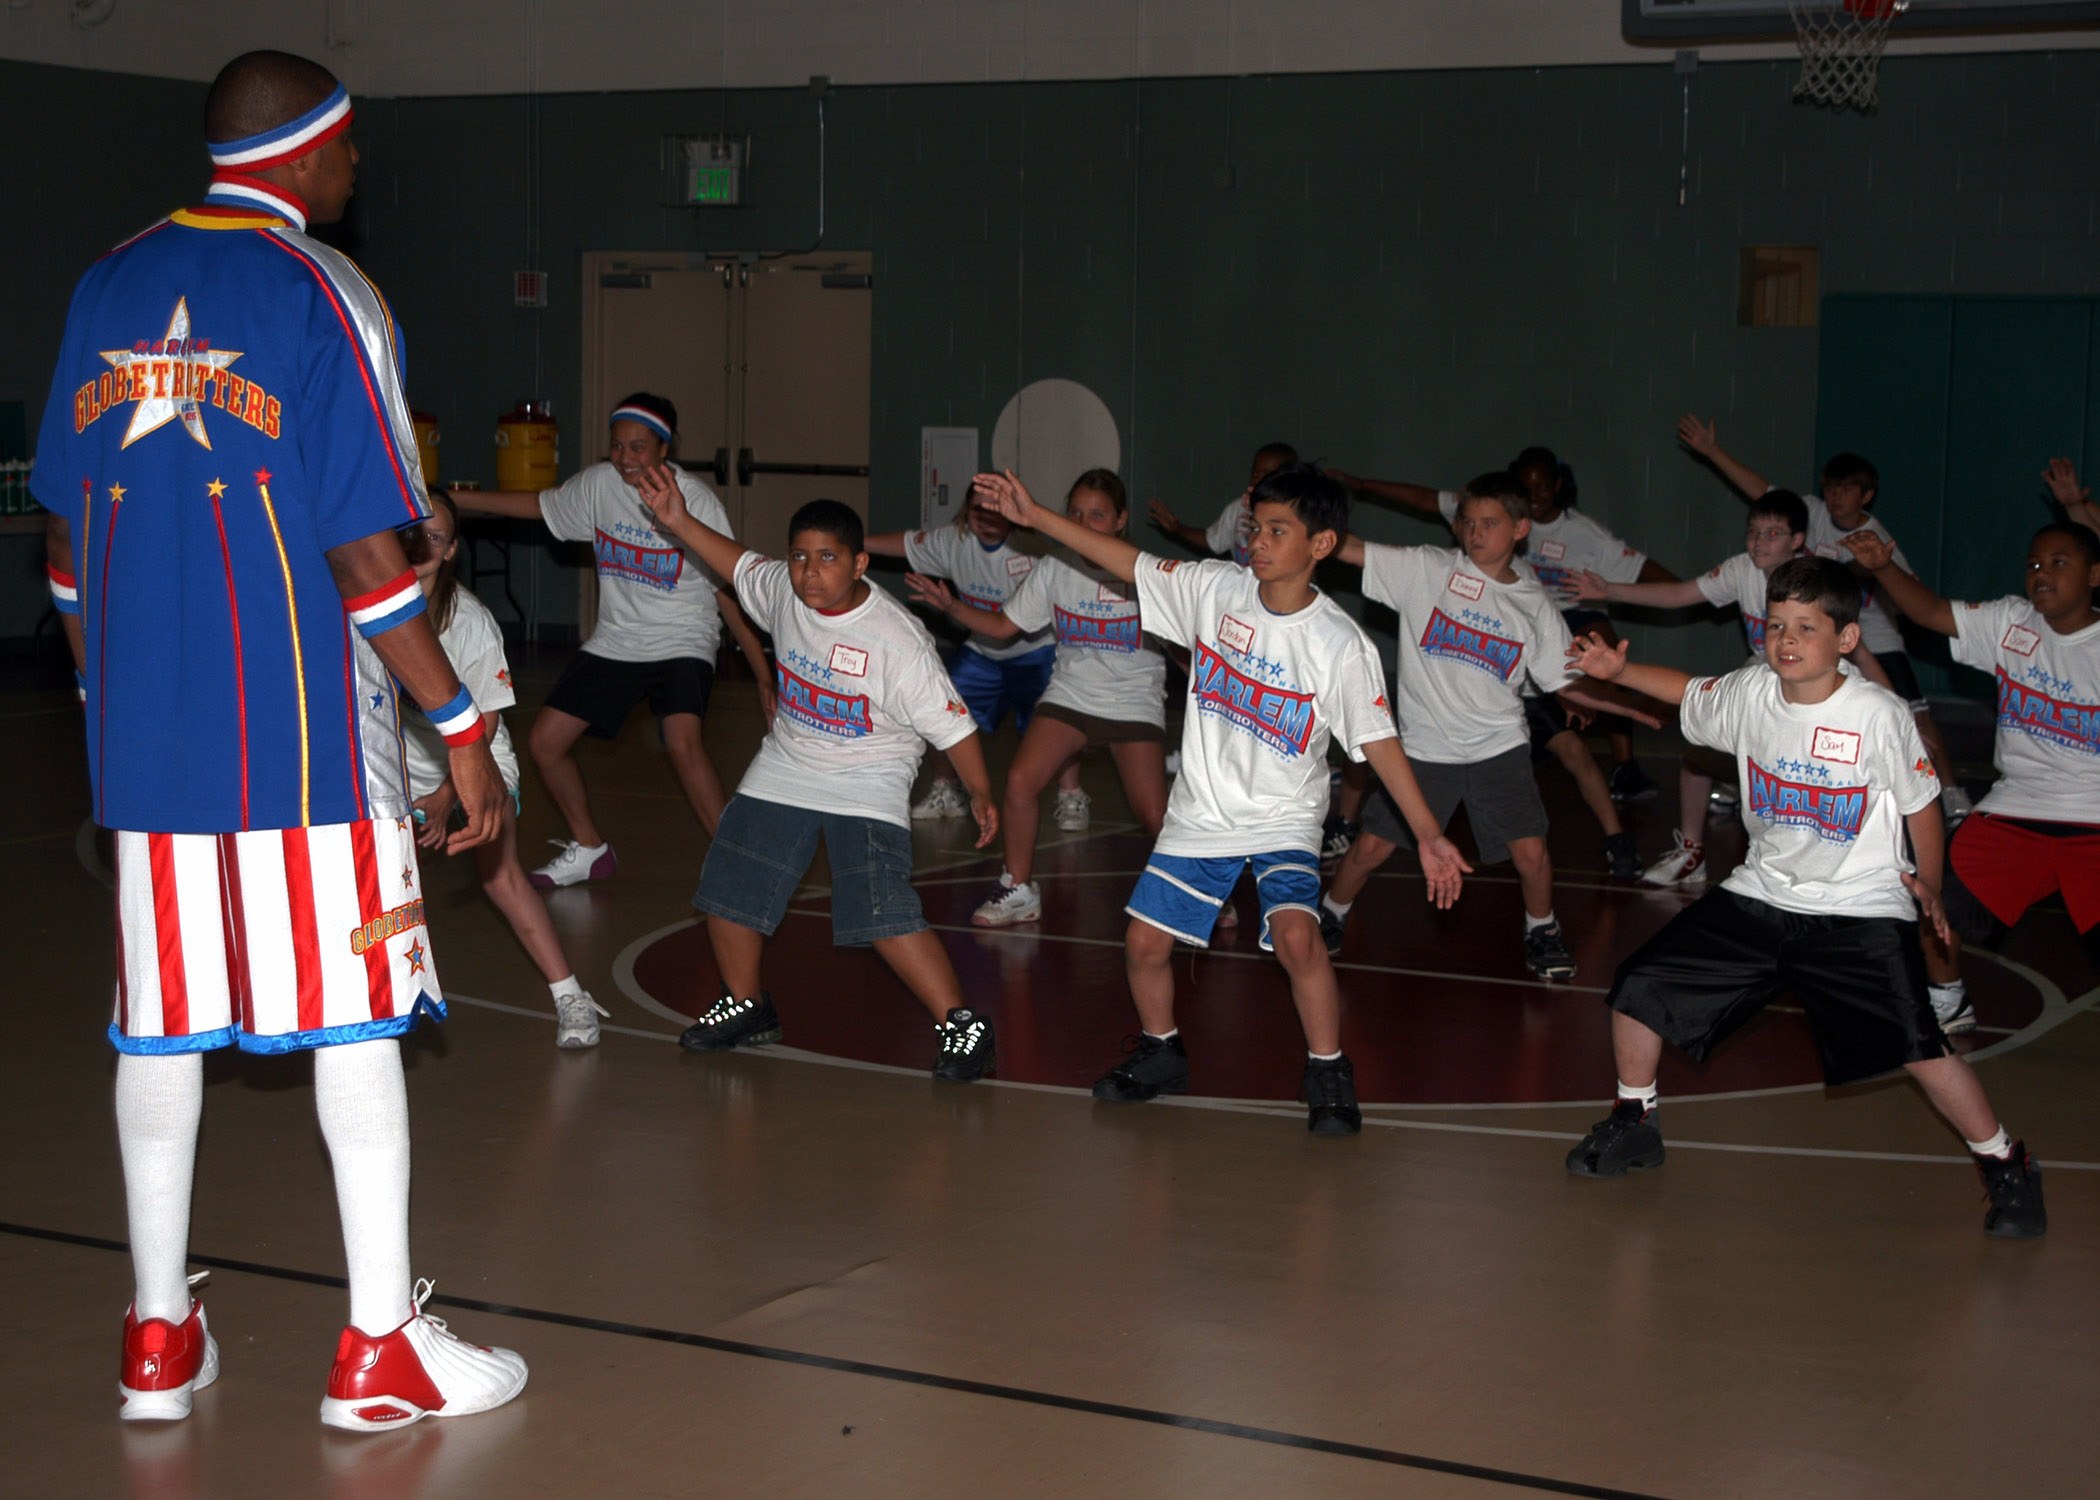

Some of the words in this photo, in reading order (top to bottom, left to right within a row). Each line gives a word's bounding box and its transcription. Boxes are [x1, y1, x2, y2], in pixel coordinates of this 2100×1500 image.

[696, 167, 731, 200] EXIT
[74, 360, 281, 440] GLOBETROTTERS
[1056, 610, 1138, 644] HARLEM
[1223, 621, 1246, 646] Jordan
[1427, 614, 1519, 671] HARLEM
[778, 668, 867, 725] RLEM
[1195, 648, 1312, 744] HARLEM
[1198, 699, 1290, 754] LOBETROTTERS
[1785, 774, 1854, 787] ORIGINAL
